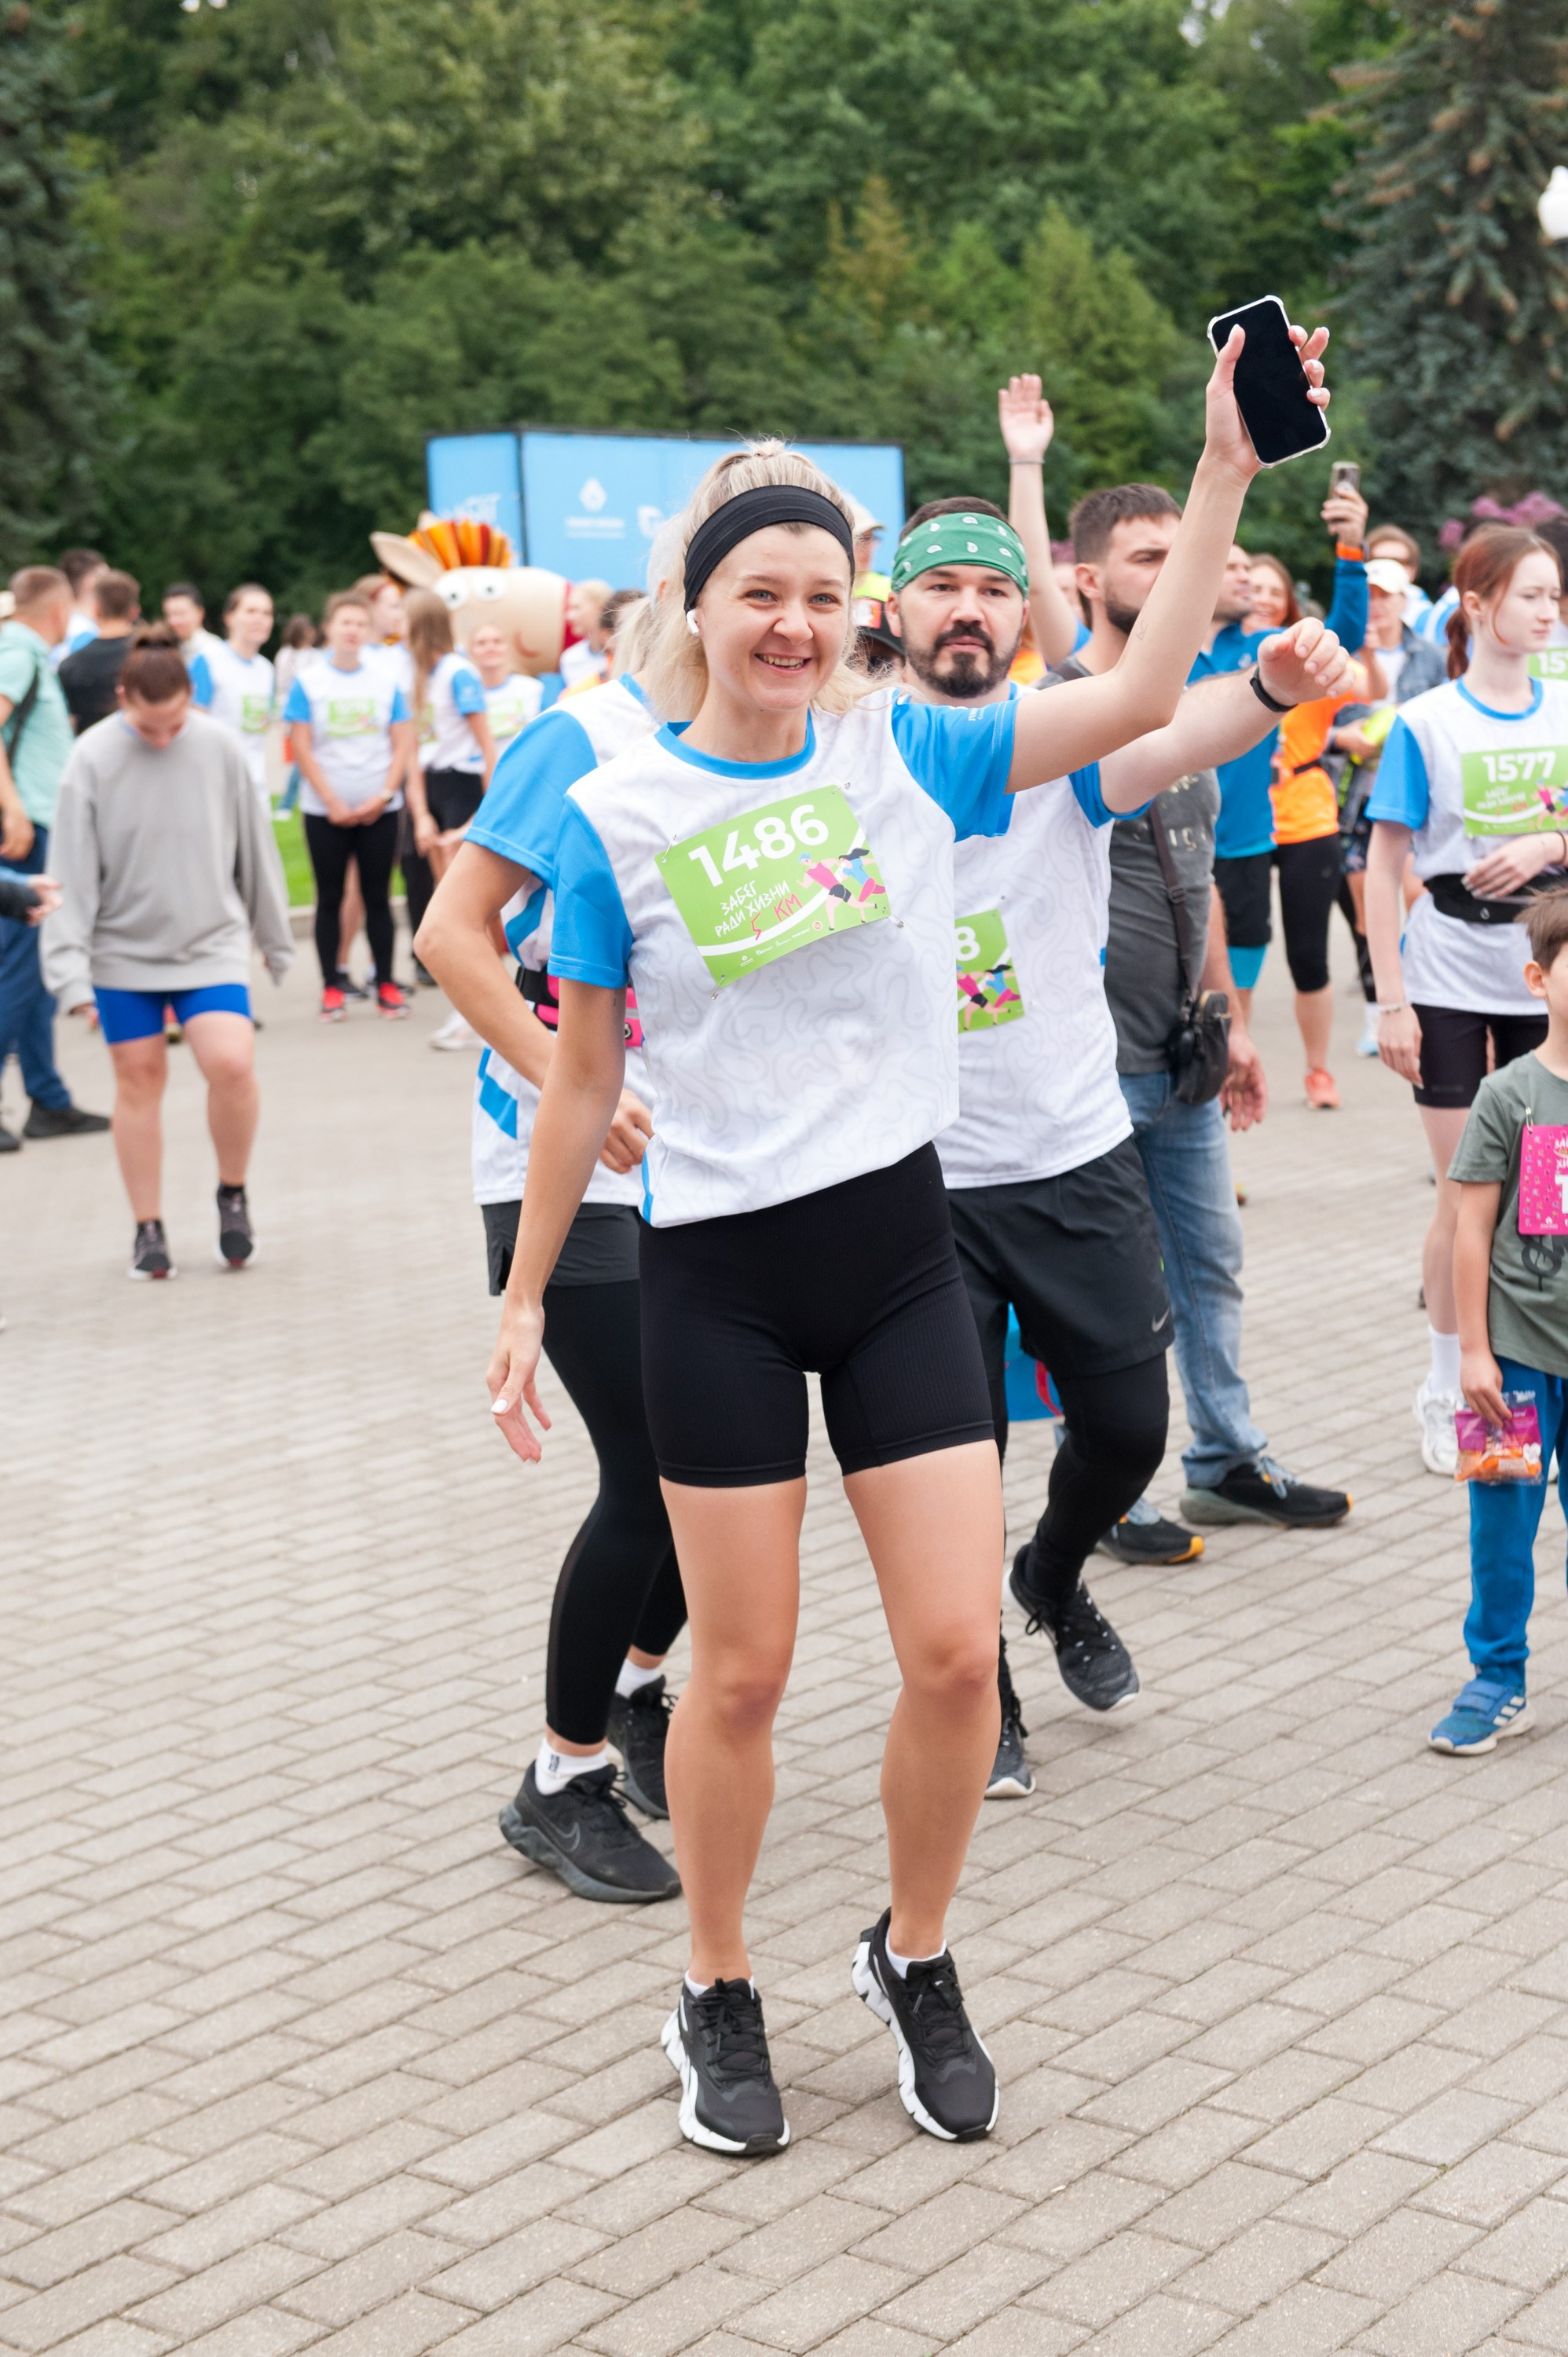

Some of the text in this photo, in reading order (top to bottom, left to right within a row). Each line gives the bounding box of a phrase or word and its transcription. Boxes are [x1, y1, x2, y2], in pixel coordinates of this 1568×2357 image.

[1537, 651, 1568, 675] 15
[1481, 750, 1556, 783] 1577
[687, 804, 829, 888] 1486
[714, 879, 791, 938] РАДИ ЖИЗНИ
[720, 879, 757, 916] ЗАБЕГ
[750, 911, 762, 941] 5
[773, 893, 804, 922] КМ
